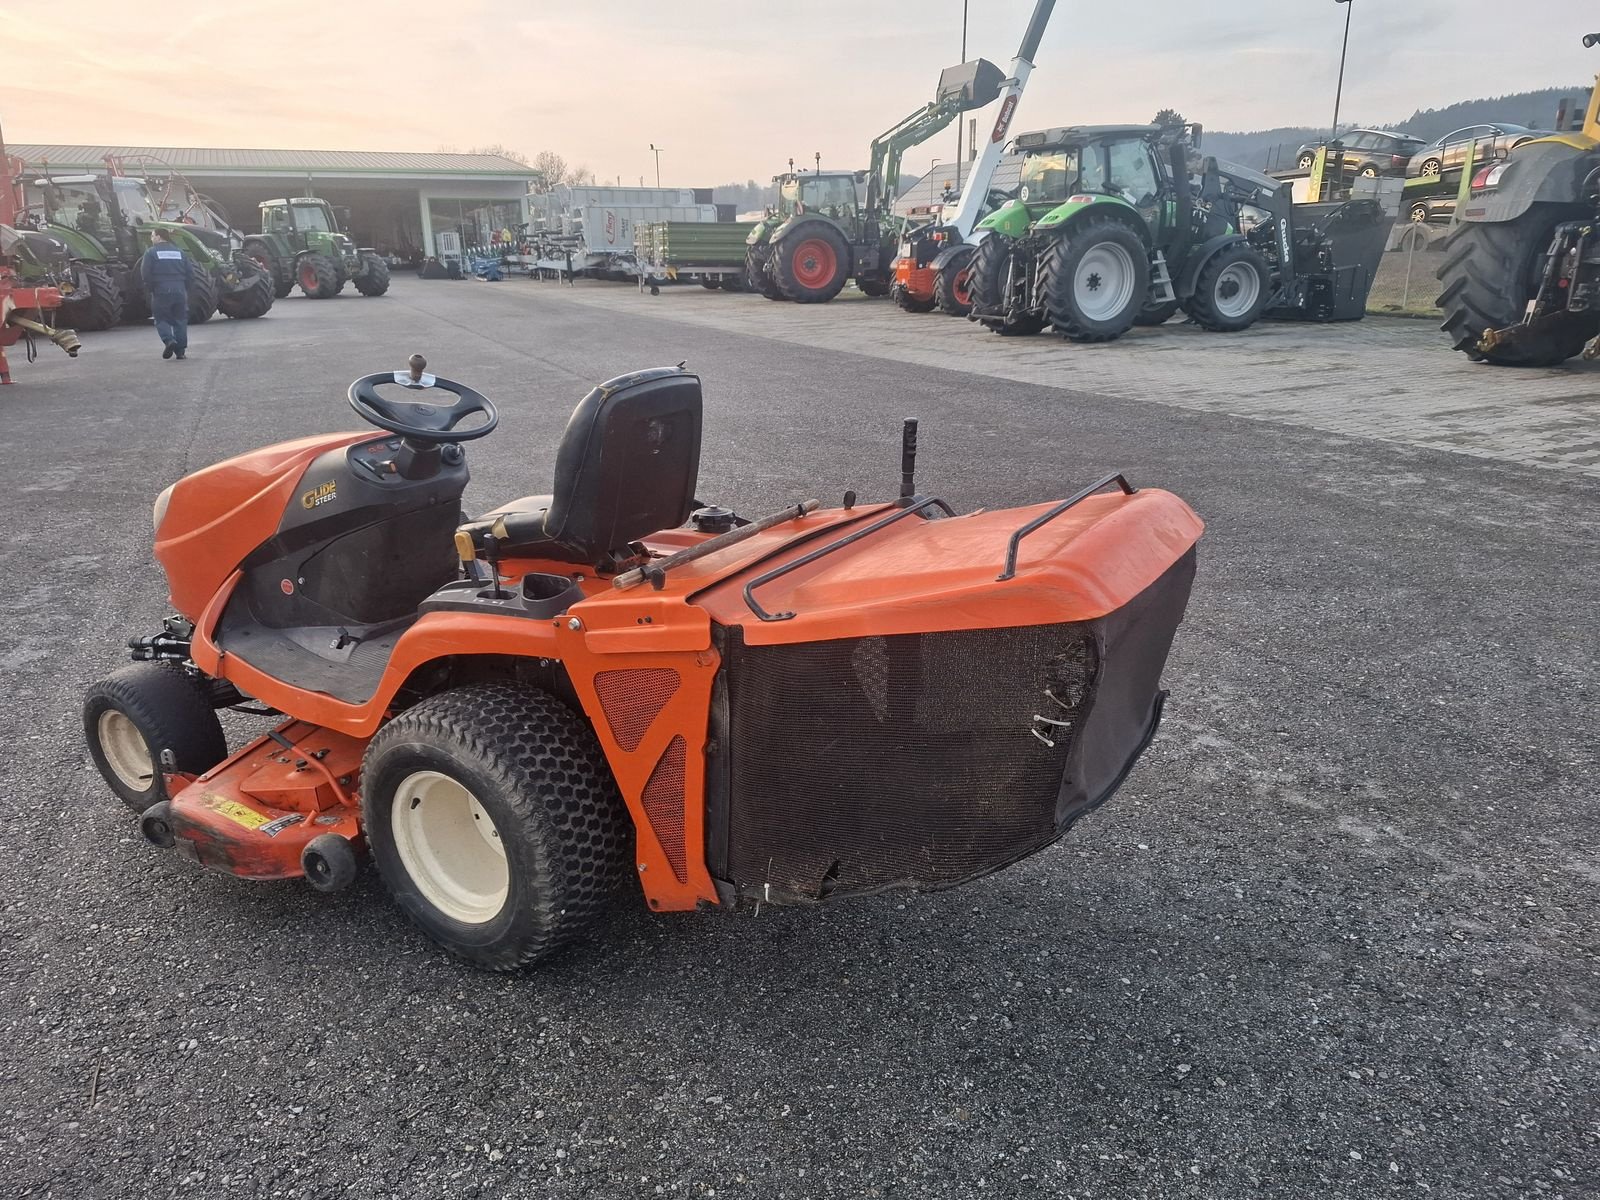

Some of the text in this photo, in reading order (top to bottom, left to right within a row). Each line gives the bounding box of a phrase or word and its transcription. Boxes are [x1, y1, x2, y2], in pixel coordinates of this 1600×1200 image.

[1280, 218, 1289, 263] Quicke
[302, 479, 337, 510] GLIDE
[314, 492, 337, 506] STEER
